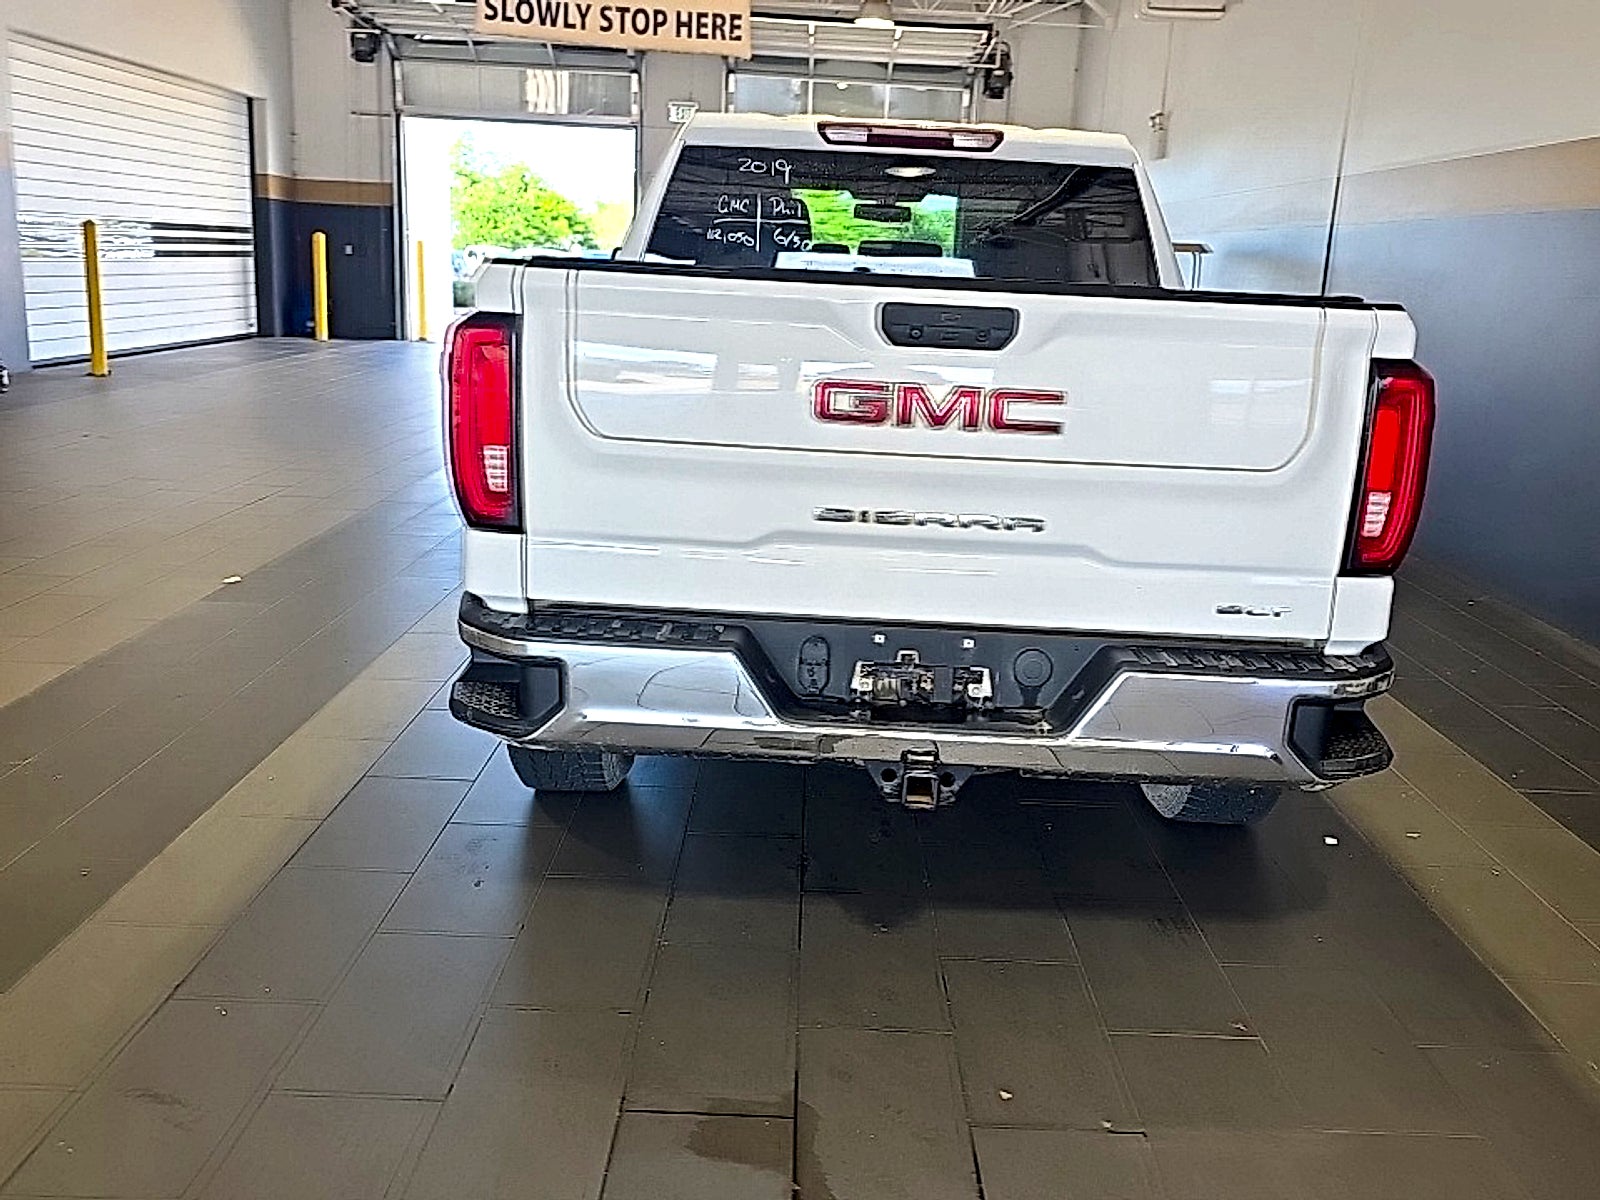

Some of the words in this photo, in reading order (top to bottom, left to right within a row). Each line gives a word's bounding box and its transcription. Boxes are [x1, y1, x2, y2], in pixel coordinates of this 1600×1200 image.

[484, 0, 592, 31] SLOWLY
[599, 5, 668, 36] STOP
[676, 10, 743, 41] HERE
[738, 157, 792, 184] 2019
[717, 195, 750, 213] GMC
[812, 378, 1067, 434] GMC
[813, 506, 1048, 532] SIERRA
